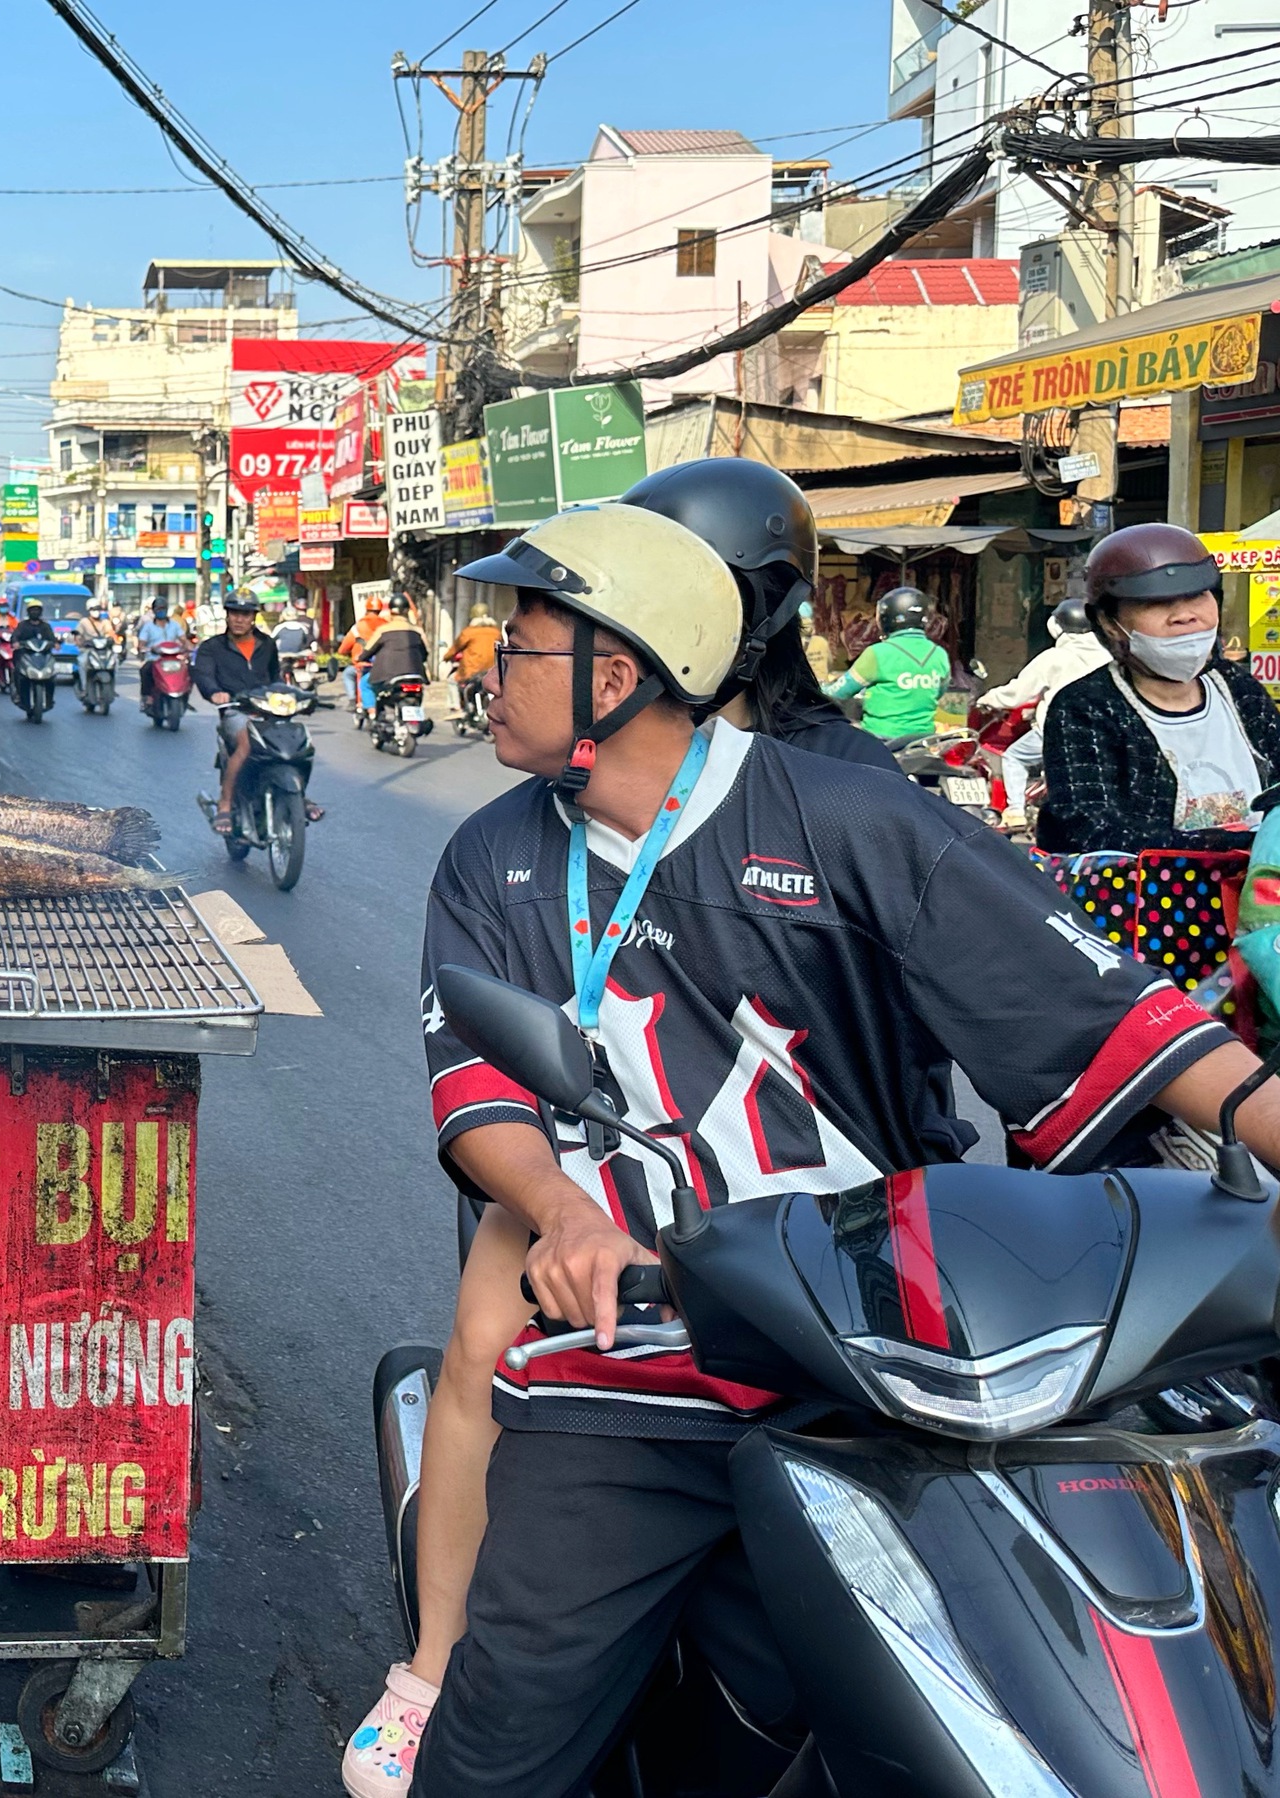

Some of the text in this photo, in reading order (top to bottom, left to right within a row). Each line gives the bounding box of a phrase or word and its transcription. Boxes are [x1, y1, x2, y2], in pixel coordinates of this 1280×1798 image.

[1032, 355, 1092, 407] TRỘN
[1094, 346, 1128, 395] DÌ
[1136, 333, 1209, 387] BẢY
[593, 435, 642, 451] Flower
[239, 453, 271, 477] 09
[396, 506, 440, 526] NAM
[897, 669, 942, 691] Grab
[1252, 654, 1280, 681] 20
[741, 866, 816, 896] ATHLETE
[35, 1121, 191, 1272] BỤI
[9, 1301, 194, 1411] NƯỚNG
[1056, 1477, 1151, 1494] HONDA
